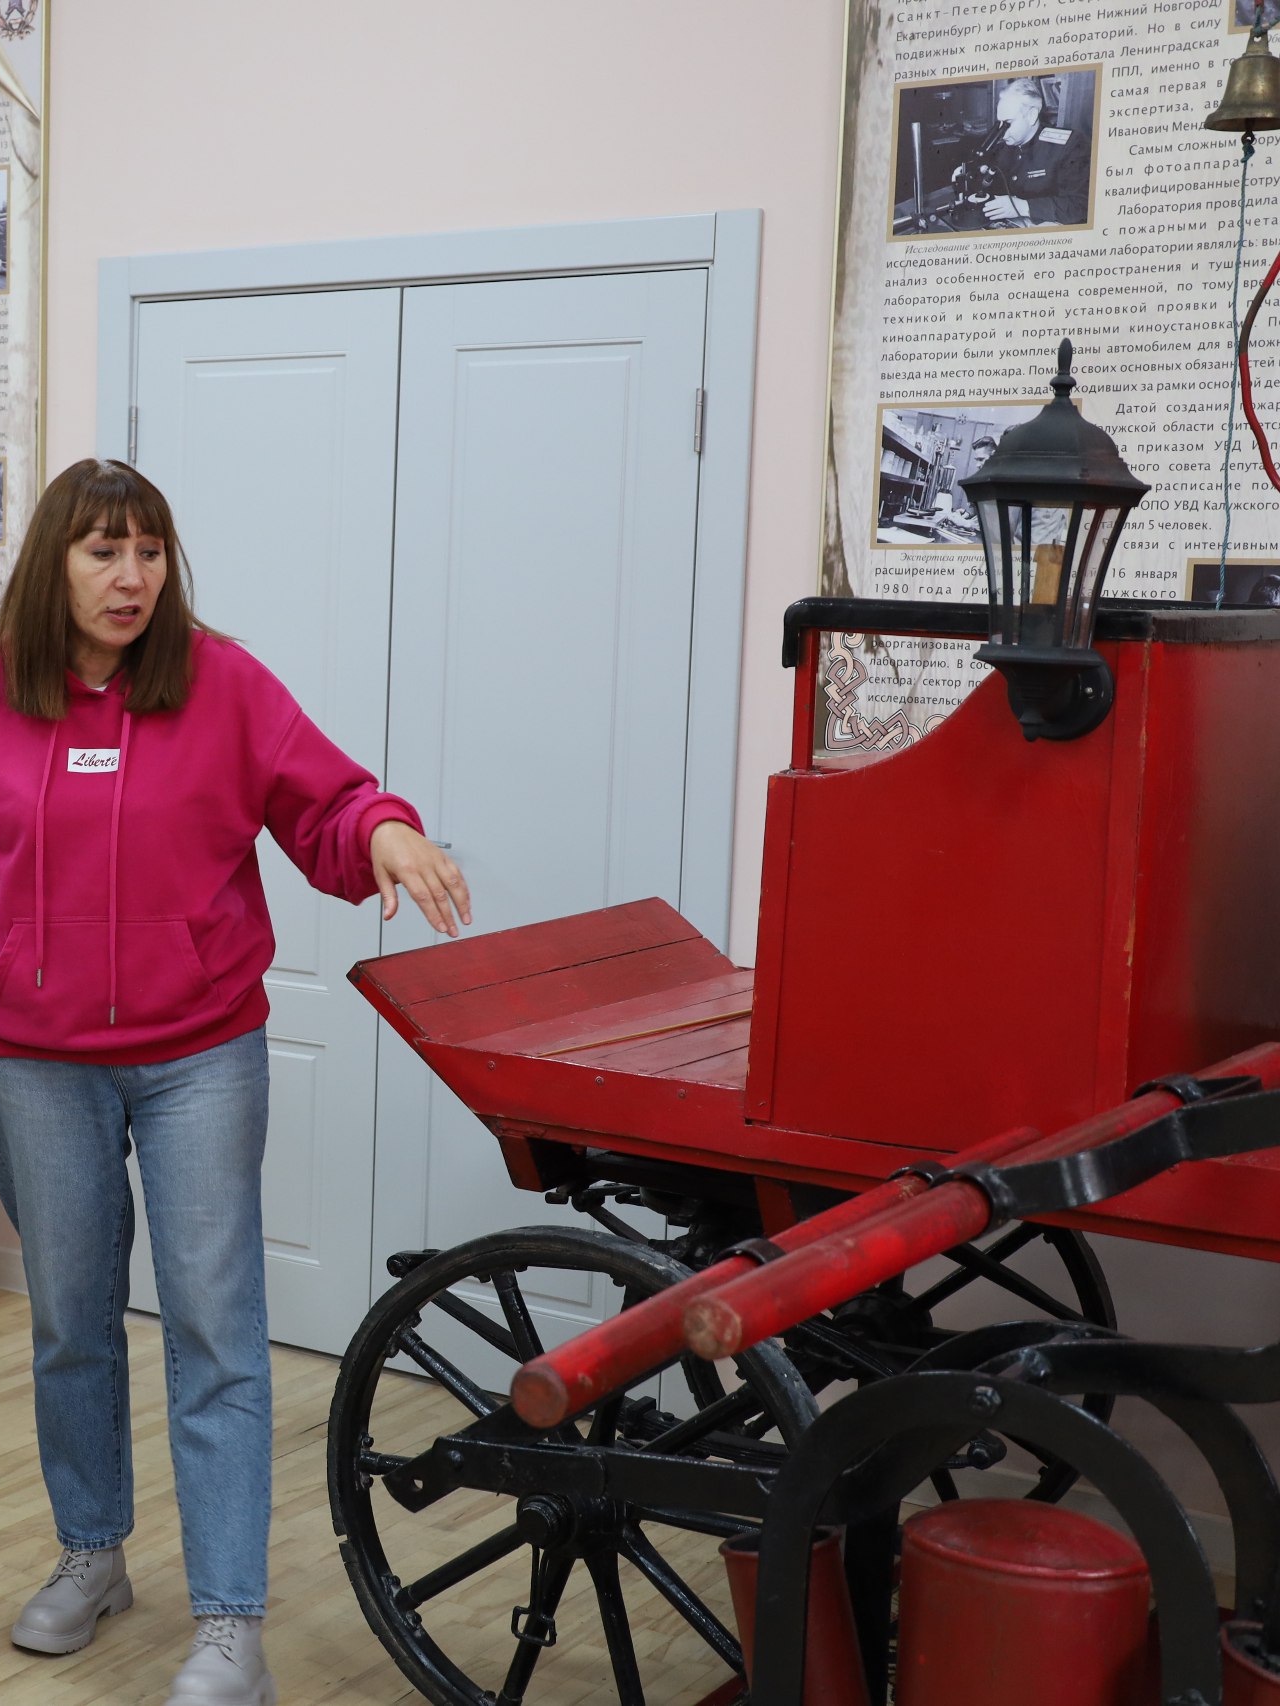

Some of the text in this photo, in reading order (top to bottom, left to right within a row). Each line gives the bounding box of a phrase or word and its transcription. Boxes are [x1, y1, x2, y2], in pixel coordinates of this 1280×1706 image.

[897, 0, 1046, 23] Санкт-Петербург),
[896, 23, 981, 42] Екатеринбург)
[987, 24, 993, 32] и
[999, 16, 1050, 31] Горьком
[1056, 12, 1091, 25] (ныне
[1097, 4, 1147, 20] Нижний
[895, 18, 1222, 61] подвижных пожарных лабораторий. Но в силу
[894, 38, 1220, 82] разных причин, первой заработала Ленинградская
[1112, 65, 1143, 78] ППЛ,
[1151, 61, 1200, 74] именно
[1208, 59, 1214, 67] в
[1110, 86, 1149, 98] самая
[1159, 80, 1206, 94] первая
[1110, 102, 1194, 118] экспертиза,
[1108, 124, 1169, 137] Иванович
[1129, 138, 1237, 156] Самым сложным
[1106, 157, 1272, 177] был а
[1105, 178, 1240, 196] квалифицированные
[1117, 203, 1202, 216] Лаборатория
[1102, 221, 1207, 236] с пожарными
[905, 237, 1073, 254] Исследование электропроводников
[886, 255, 973, 269] исследований.
[976, 252, 1046, 264] Основными
[1048, 248, 1107, 260] задачами
[1109, 244, 1194, 256] лаборатории
[885, 262, 1199, 288] анализ особенностей его распространения и
[884, 279, 1233, 306] лаборатория была оснащена современной, по тому
[883, 301, 1217, 324] техникой и компактной установкой проявки
[882, 325, 1120, 343] киноаппаратурой и портативными
[881, 349, 958, 362] лаборатории
[964, 347, 994, 359] были
[1106, 340, 1191, 354] автомобилем
[1198, 340, 1220, 351] для
[880, 370, 921, 380] выезда
[924, 370, 937, 379] на
[940, 368, 975, 378] место
[978, 366, 1025, 379] пожара.
[1081, 363, 1117, 374] своих
[1120, 362, 1182, 372] основных
[879, 381, 1196, 399] выполняла ряд научных за рамки
[1116, 402, 1229, 415] Датой создания
[1163, 422, 1214, 432] области
[1138, 442, 1204, 452] приказом
[1169, 462, 1211, 471] совета
[1155, 481, 1241, 492] расписание
[1174, 500, 1199, 511] УВД
[1149, 520, 1155, 530] 5
[1158, 521, 1212, 530] человек.
[1124, 541, 1159, 549] связи
[1169, 541, 1175, 549] с
[900, 553, 955, 562] Экспертиза
[875, 566, 1178, 581] расширением 16 января
[875, 584, 909, 593] 1980
[919, 586, 952, 595] года
[872, 639, 970, 651] реорганизована
[870, 657, 950, 668] лабораторию.
[957, 659, 963, 668] В
[868, 675, 961, 688] сектора: сектор
